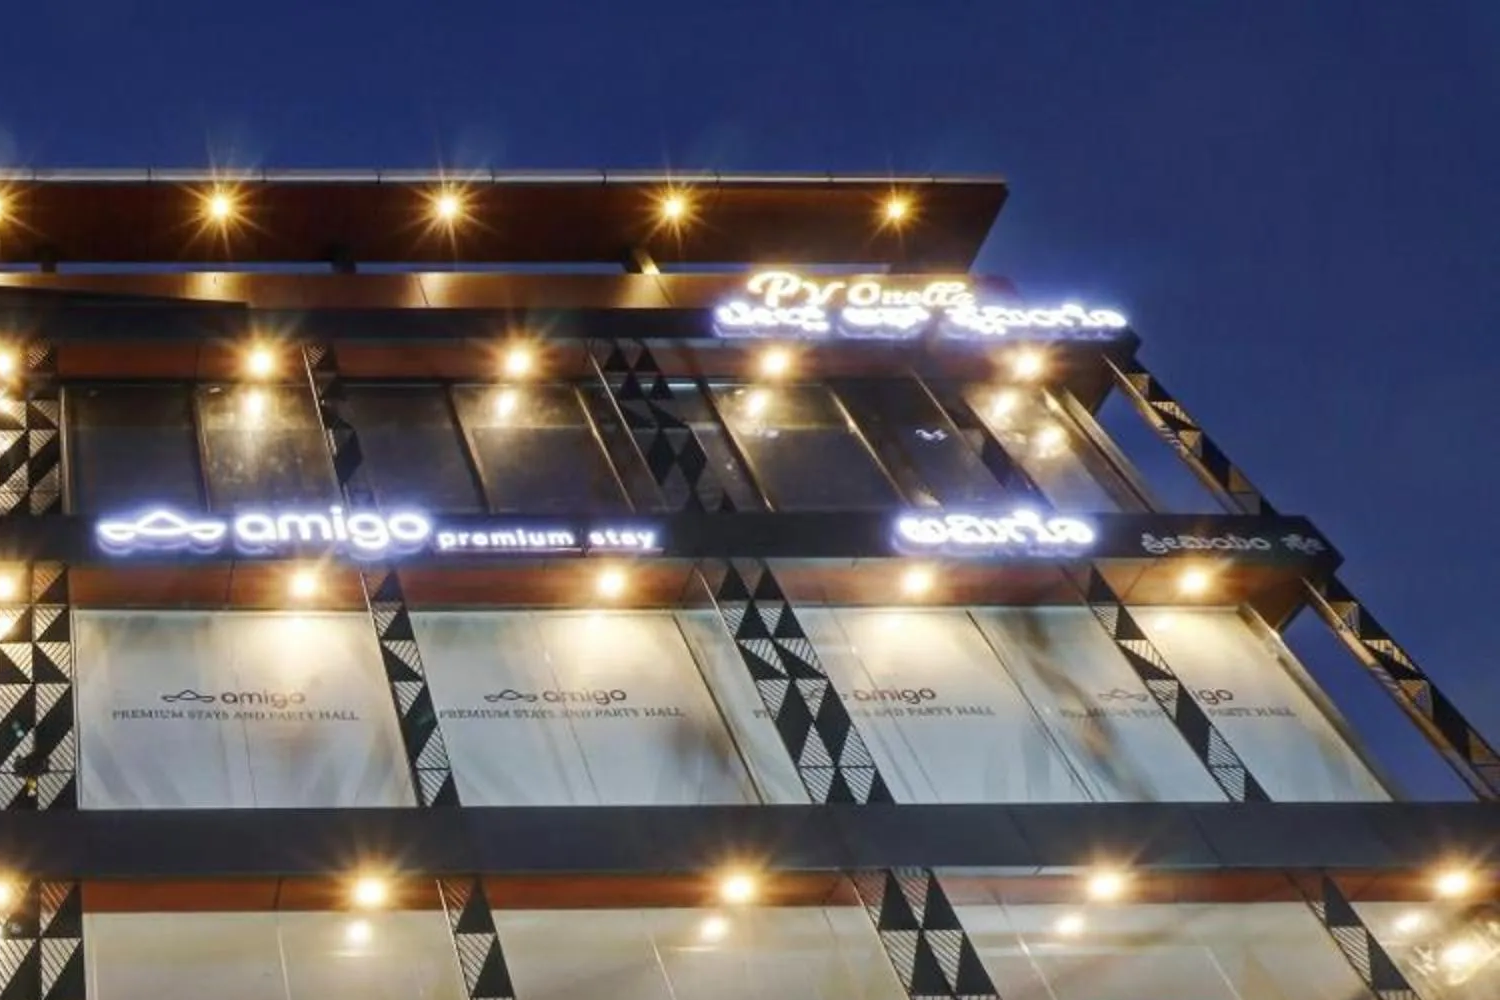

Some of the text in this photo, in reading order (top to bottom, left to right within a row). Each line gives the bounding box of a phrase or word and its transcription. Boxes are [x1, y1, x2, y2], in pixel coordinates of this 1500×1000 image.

[235, 506, 657, 550] amigo premium stay
[220, 688, 307, 708] amigo
[543, 687, 627, 706] amigo
[853, 685, 937, 705] amigo
[1193, 685, 1234, 705] igo
[112, 709, 184, 721] PREMIUM
[187, 710, 229, 721] STAYS
[233, 711, 267, 722] AND
[318, 711, 360, 722] HALL
[438, 708, 509, 720] PREMIUM
[594, 708, 641, 719] PARTY
[644, 706, 685, 718] HALL
[956, 705, 996, 717] HALL
